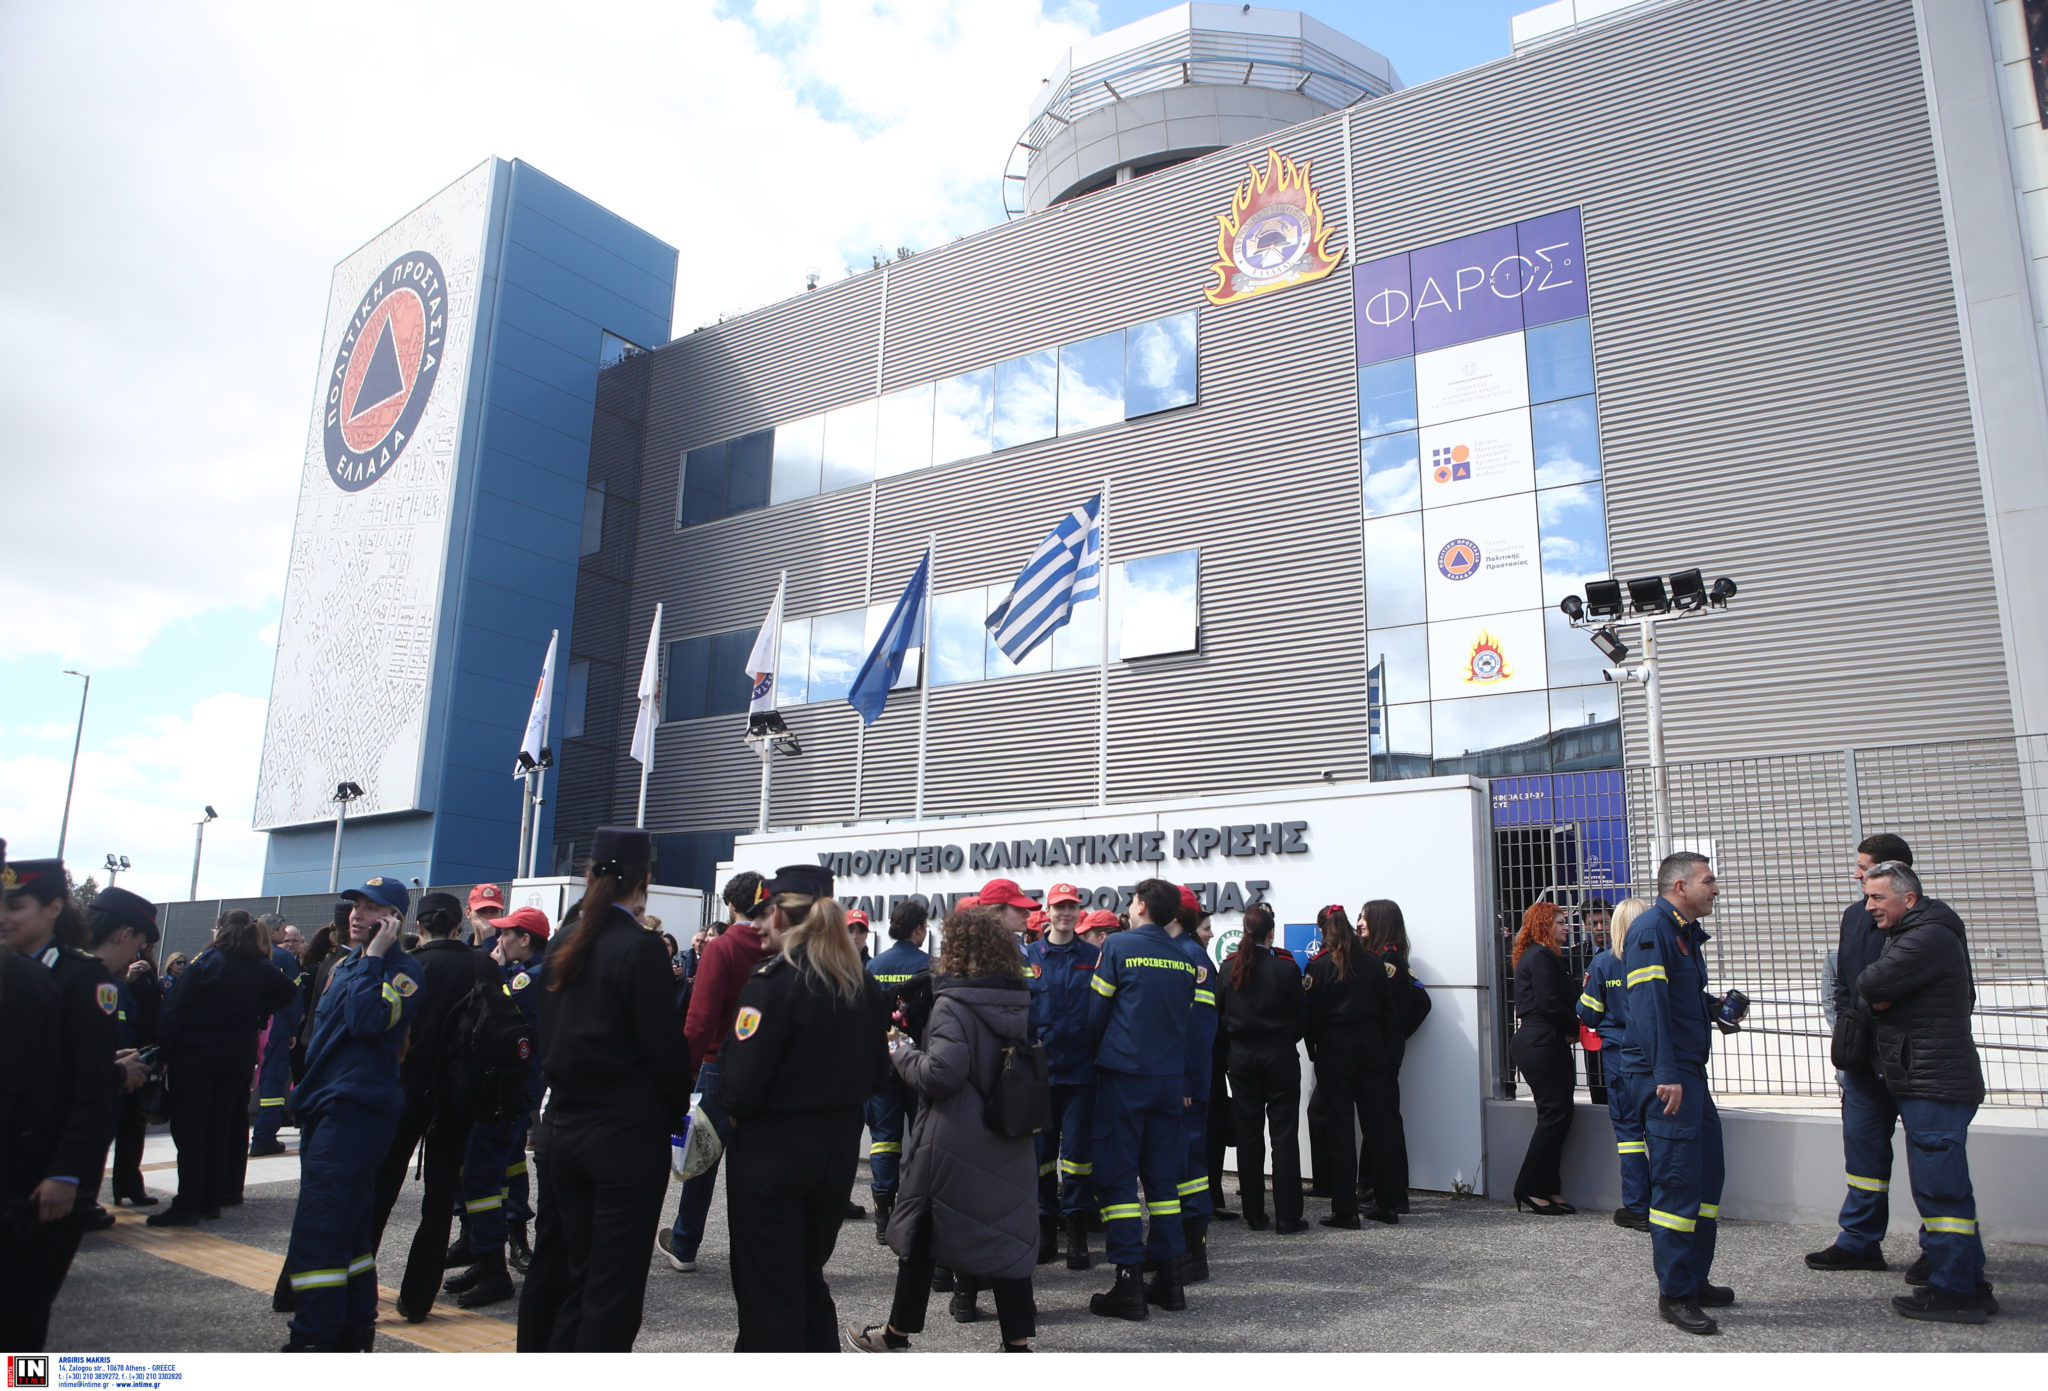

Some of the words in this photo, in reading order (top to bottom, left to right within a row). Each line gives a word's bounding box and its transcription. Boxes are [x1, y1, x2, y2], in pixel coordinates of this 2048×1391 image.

[1366, 242, 1573, 328] ΦΑΡΟΣ
[327, 281, 383, 428] ΠΟΛΙΤΙΚΗ
[391, 261, 442, 373] ΠΡΟΣΤΑΣΙΑ
[336, 430, 405, 482] ΕΛΛΑΔΑ
[1486, 553, 1520, 563] Πολιτικής
[1486, 560, 1529, 571] Προστασίας
[818, 844, 965, 877] ΥΠΟΥΡΓΕΙΟ
[969, 830, 1165, 869] ΚΛΙΜΑΤΙΚΗΣ
[1173, 820, 1308, 859] ΚΡΙΣΗΣ
[838, 895, 884, 922] ΚΑΙ
[1125, 957, 1185, 971] ΠΥΡΟΣΒΕΣΤΙΚΟ
